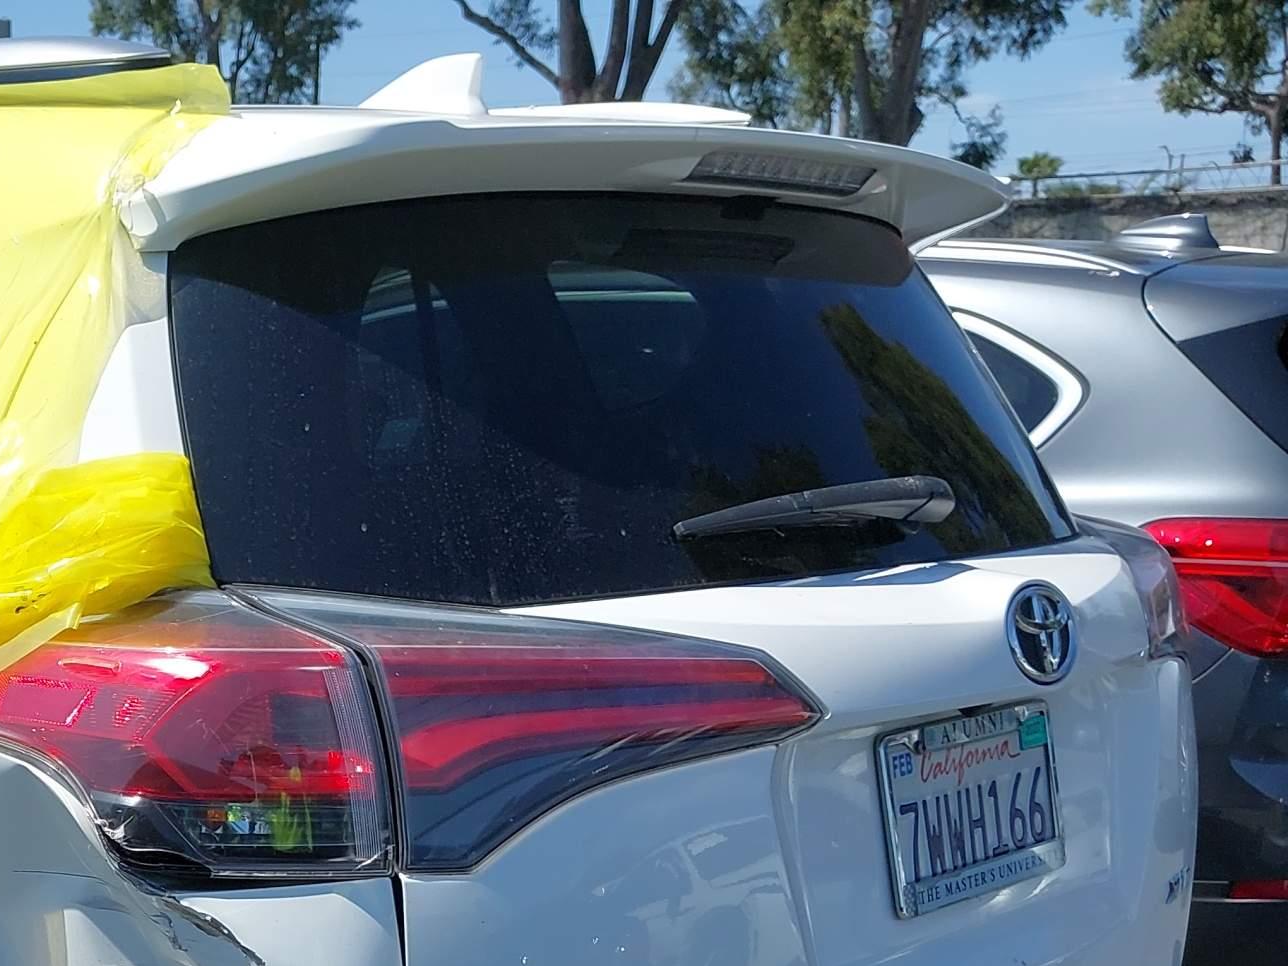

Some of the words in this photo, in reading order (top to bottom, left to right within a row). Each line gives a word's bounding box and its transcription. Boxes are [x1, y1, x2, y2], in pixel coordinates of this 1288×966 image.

[892, 754, 913, 780] FEB
[920, 740, 1021, 787] California
[899, 766, 1047, 884] 7WWH166
[918, 887, 941, 906] THE
[944, 866, 997, 901] MASTER'S
